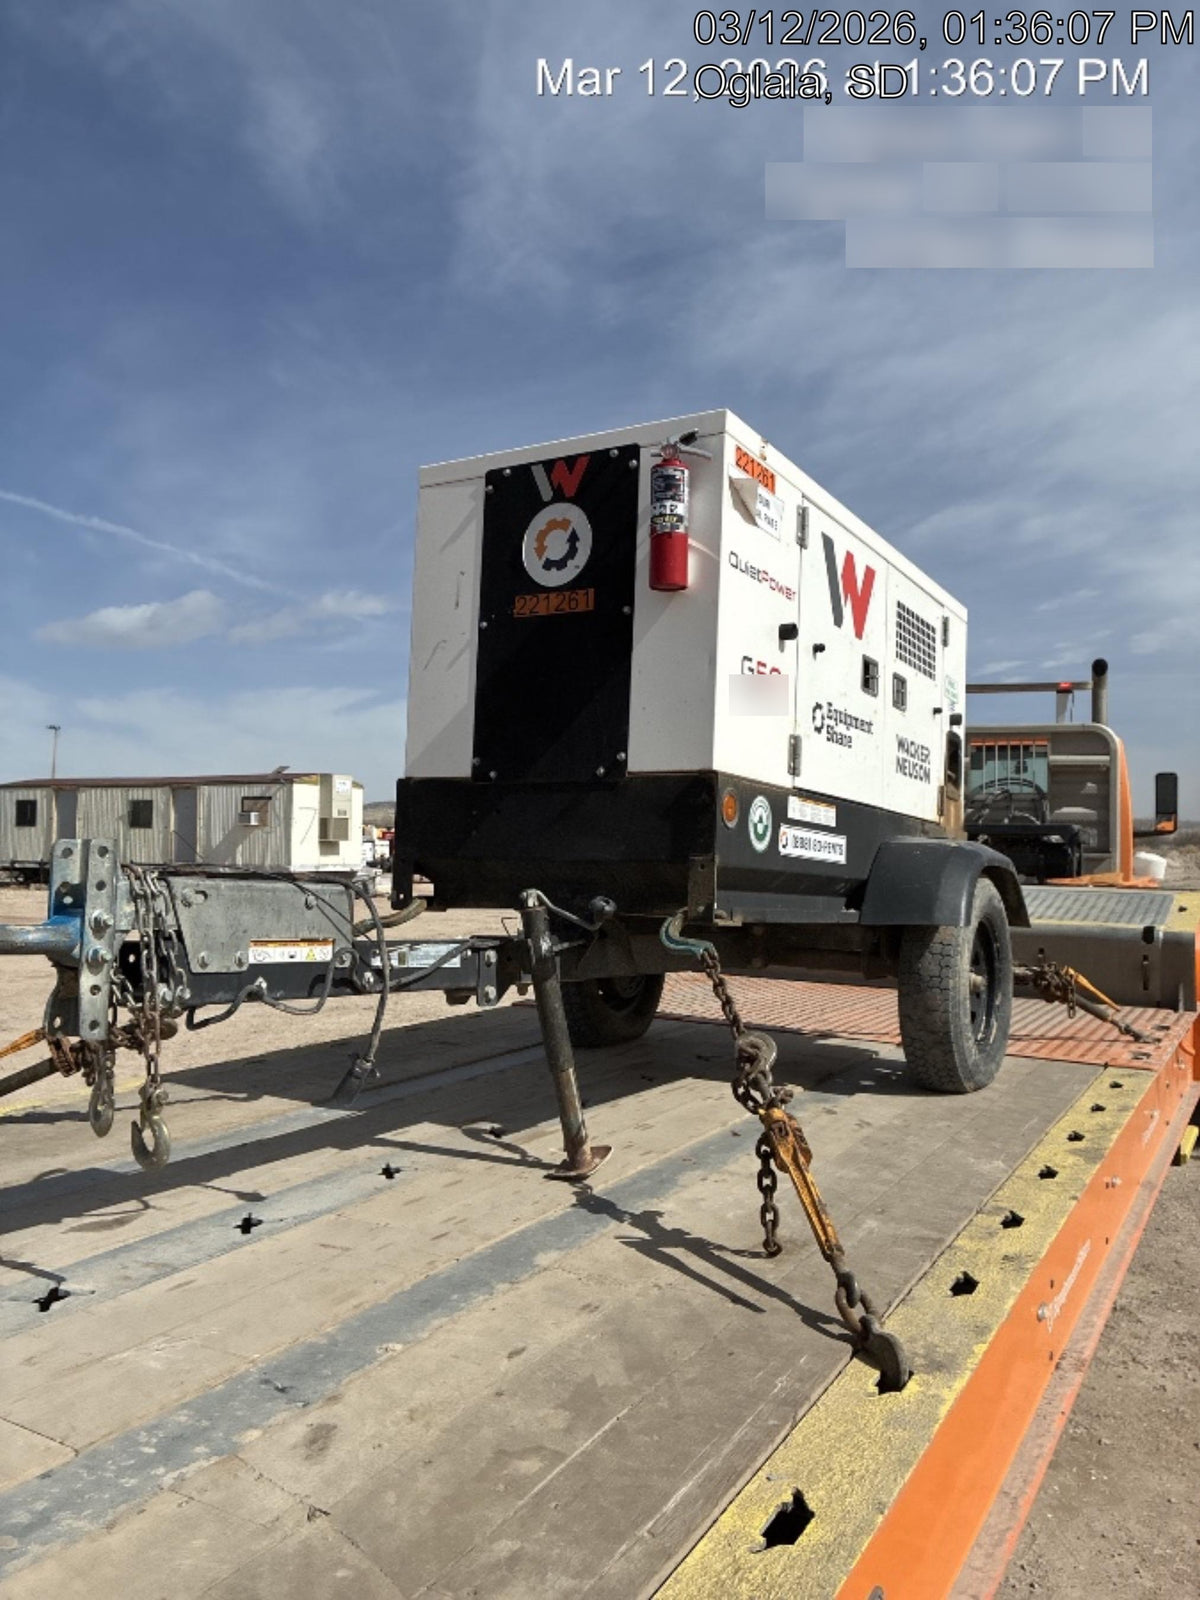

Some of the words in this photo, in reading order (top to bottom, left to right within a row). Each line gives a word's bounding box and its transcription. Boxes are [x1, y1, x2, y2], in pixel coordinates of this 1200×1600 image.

[735, 445, 776, 494] 221261
[516, 591, 591, 616] 221261
[826, 702, 874, 735] Equipment
[826, 724, 853, 749] Share
[896, 733, 931, 765] WACKER
[896, 755, 931, 785] NEUSON
